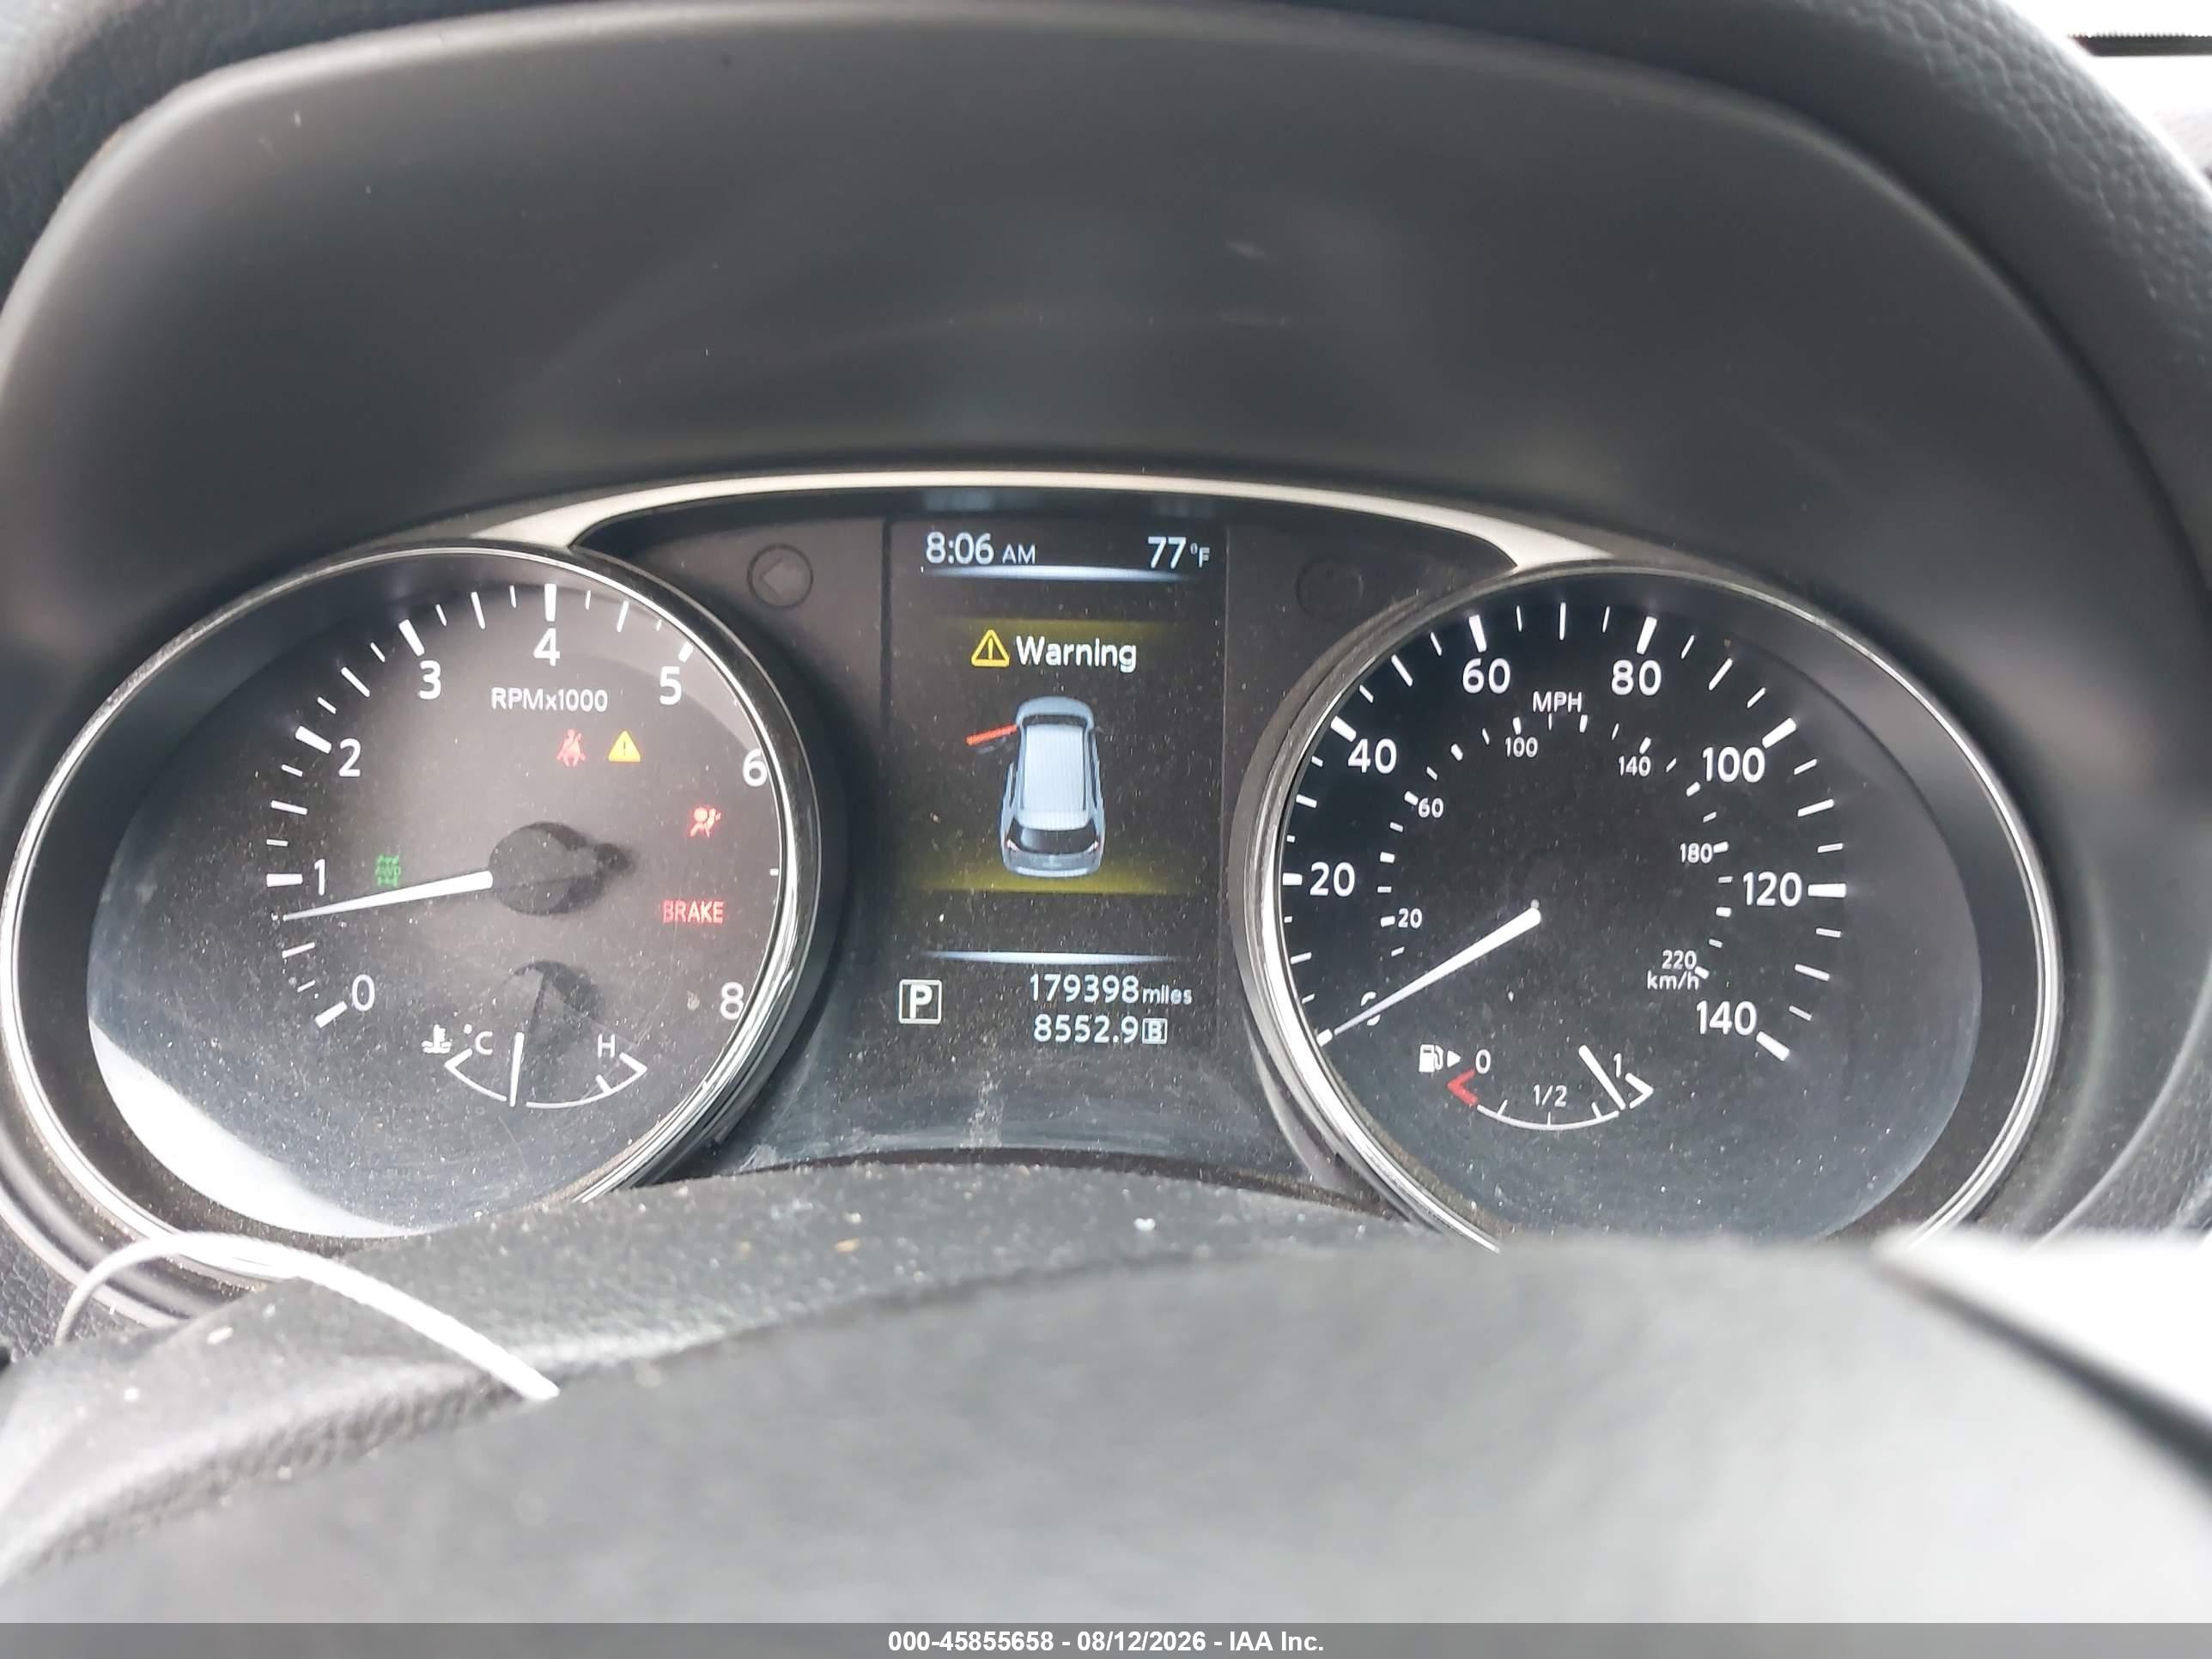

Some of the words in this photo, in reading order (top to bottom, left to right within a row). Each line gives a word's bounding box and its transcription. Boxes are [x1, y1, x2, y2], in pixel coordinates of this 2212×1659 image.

[925, 532, 994, 565] 8:06
[1001, 544, 1036, 564] AM
[533, 628, 561, 666] 4
[1016, 635, 1137, 673] Warning
[418, 660, 442, 700] 3
[659, 665, 683, 705] 5
[1462, 658, 1511, 694] 60
[1611, 659, 1662, 696] 80
[491, 687, 609, 713] RPMx1000
[1532, 690, 1583, 713] MPH
[338, 738, 362, 777] 2
[1347, 739, 1398, 773] 40
[1504, 737, 1539, 758] 100
[1702, 747, 1765, 782] 100
[743, 748, 769, 787] 6
[1618, 756, 1651, 777] 140
[1418, 798, 1444, 818] 60
[1679, 842, 1713, 864] 180
[313, 858, 325, 896] 1
[1310, 861, 1356, 897] 20
[1742, 872, 1803, 907] 120
[663, 899, 724, 924] BRAKE
[1398, 908, 1424, 929] 20
[1662, 949, 1698, 970] 220
[351, 975, 375, 1012] 0
[1647, 969, 1699, 990] km/h
[720, 981, 744, 1021] 8
[909, 983, 933, 1019] P
[1696, 1000, 1757, 1036] 140
[1033, 1013, 1139, 1044] 8552.9
[597, 1033, 617, 1059] H
[1474, 1048, 1492, 1075] 0
[1613, 1053, 1623, 1079] 1
[1533, 1084, 1568, 1108] 1/2
